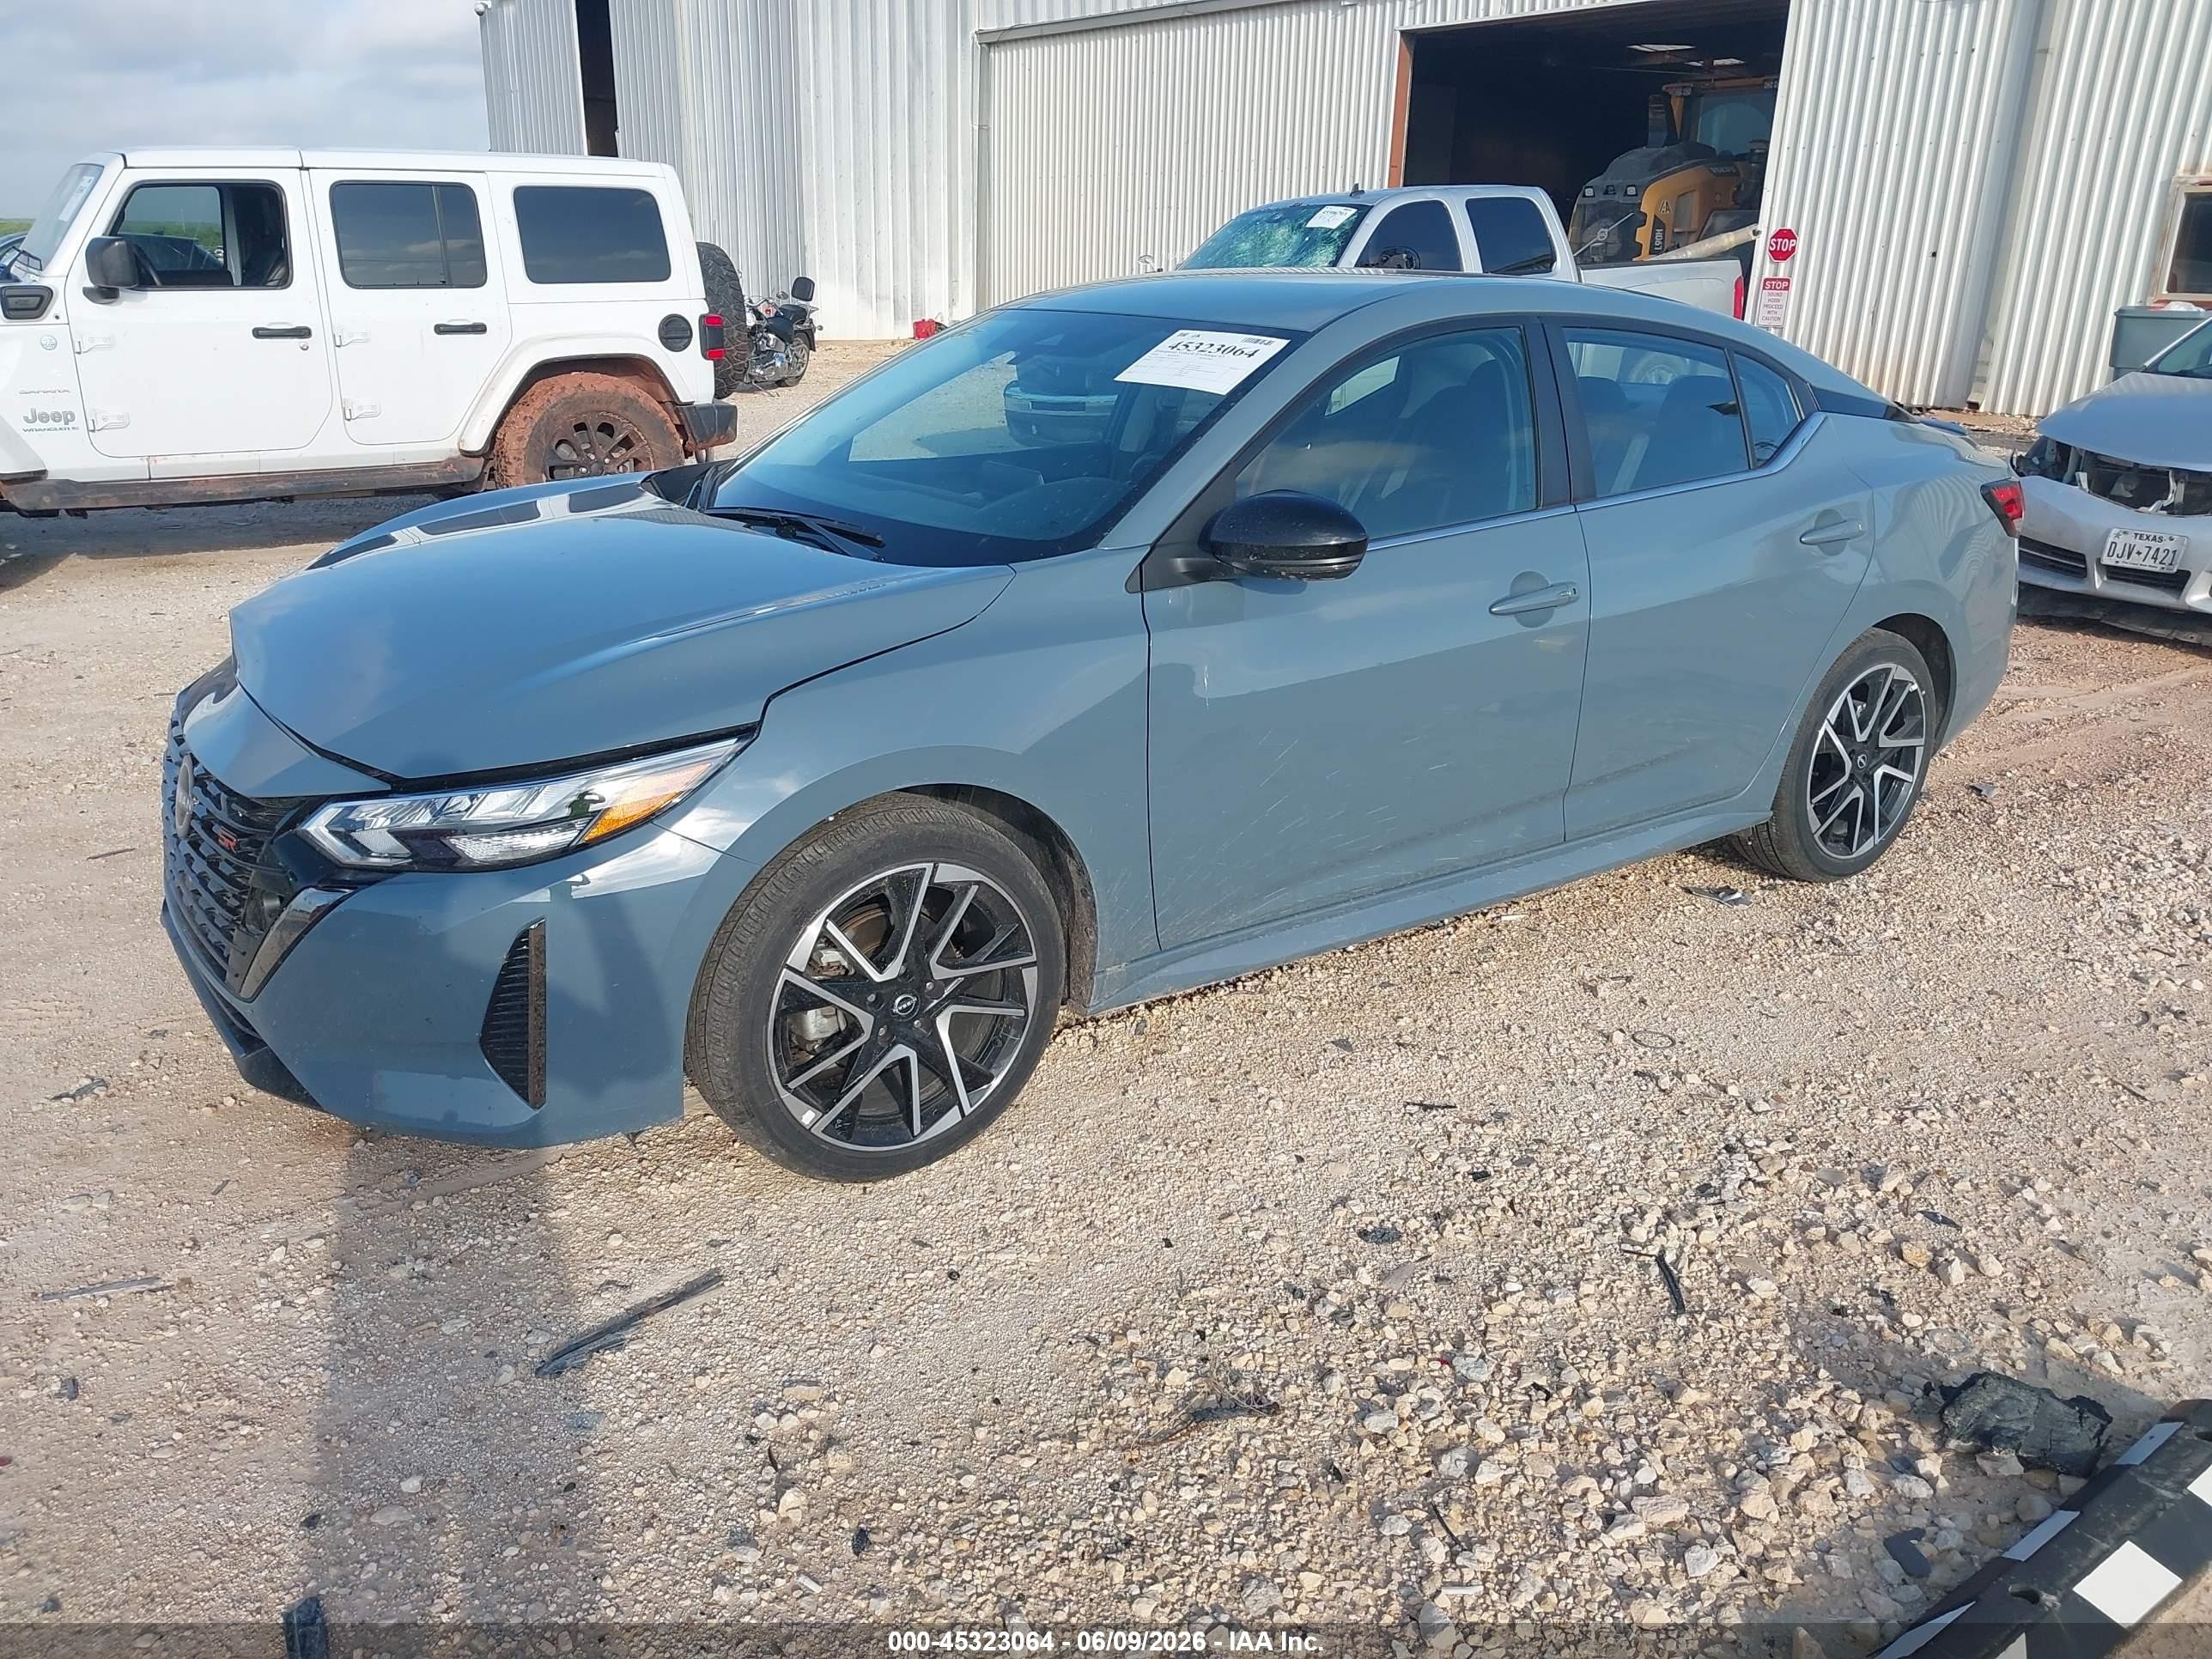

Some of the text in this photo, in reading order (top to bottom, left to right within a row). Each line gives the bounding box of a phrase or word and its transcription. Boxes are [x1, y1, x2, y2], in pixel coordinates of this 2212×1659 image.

[1654, 228, 1663, 251] L90H
[1769, 238, 1796, 252] STOP
[1765, 281, 1789, 290] STOP
[1168, 340, 1261, 358] 45323064
[22, 407, 76, 426] Jeep
[2133, 532, 2164, 544] TEXAS
